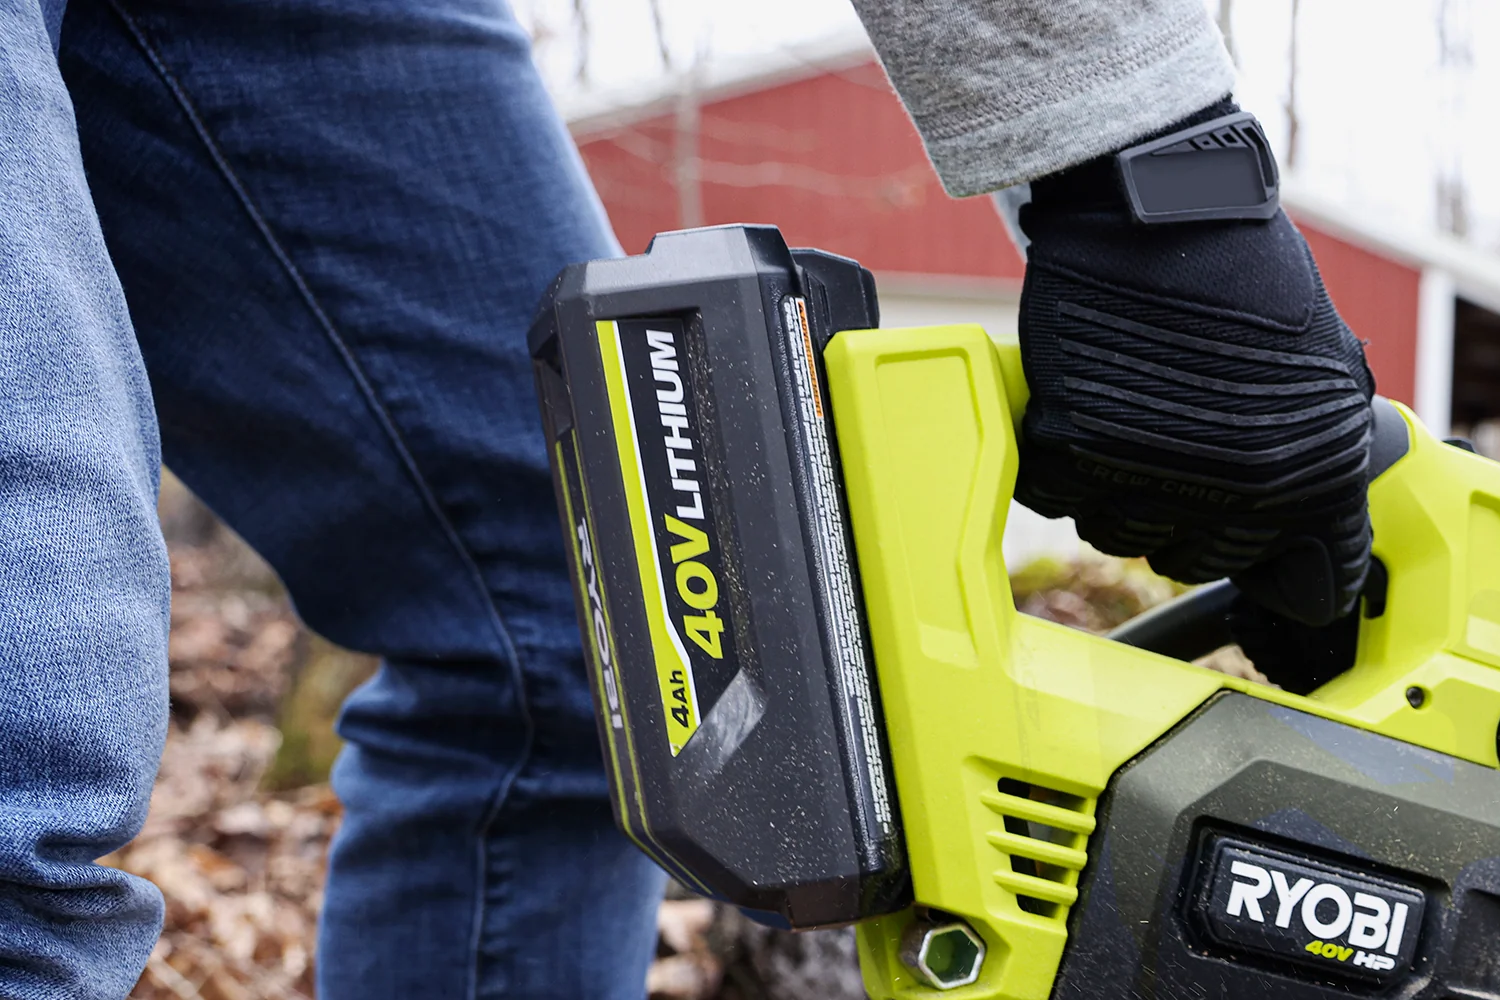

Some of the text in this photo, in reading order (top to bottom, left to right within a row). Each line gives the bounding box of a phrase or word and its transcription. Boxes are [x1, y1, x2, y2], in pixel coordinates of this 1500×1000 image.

[646, 329, 724, 659] 40V LITHIUM
[1075, 458, 1242, 506] CREW CHIEF
[577, 517, 623, 728] RYOBI
[669, 669, 690, 728] 4Ah
[1226, 860, 1409, 956] RYOBI
[1305, 940, 1396, 971] 40V HP
